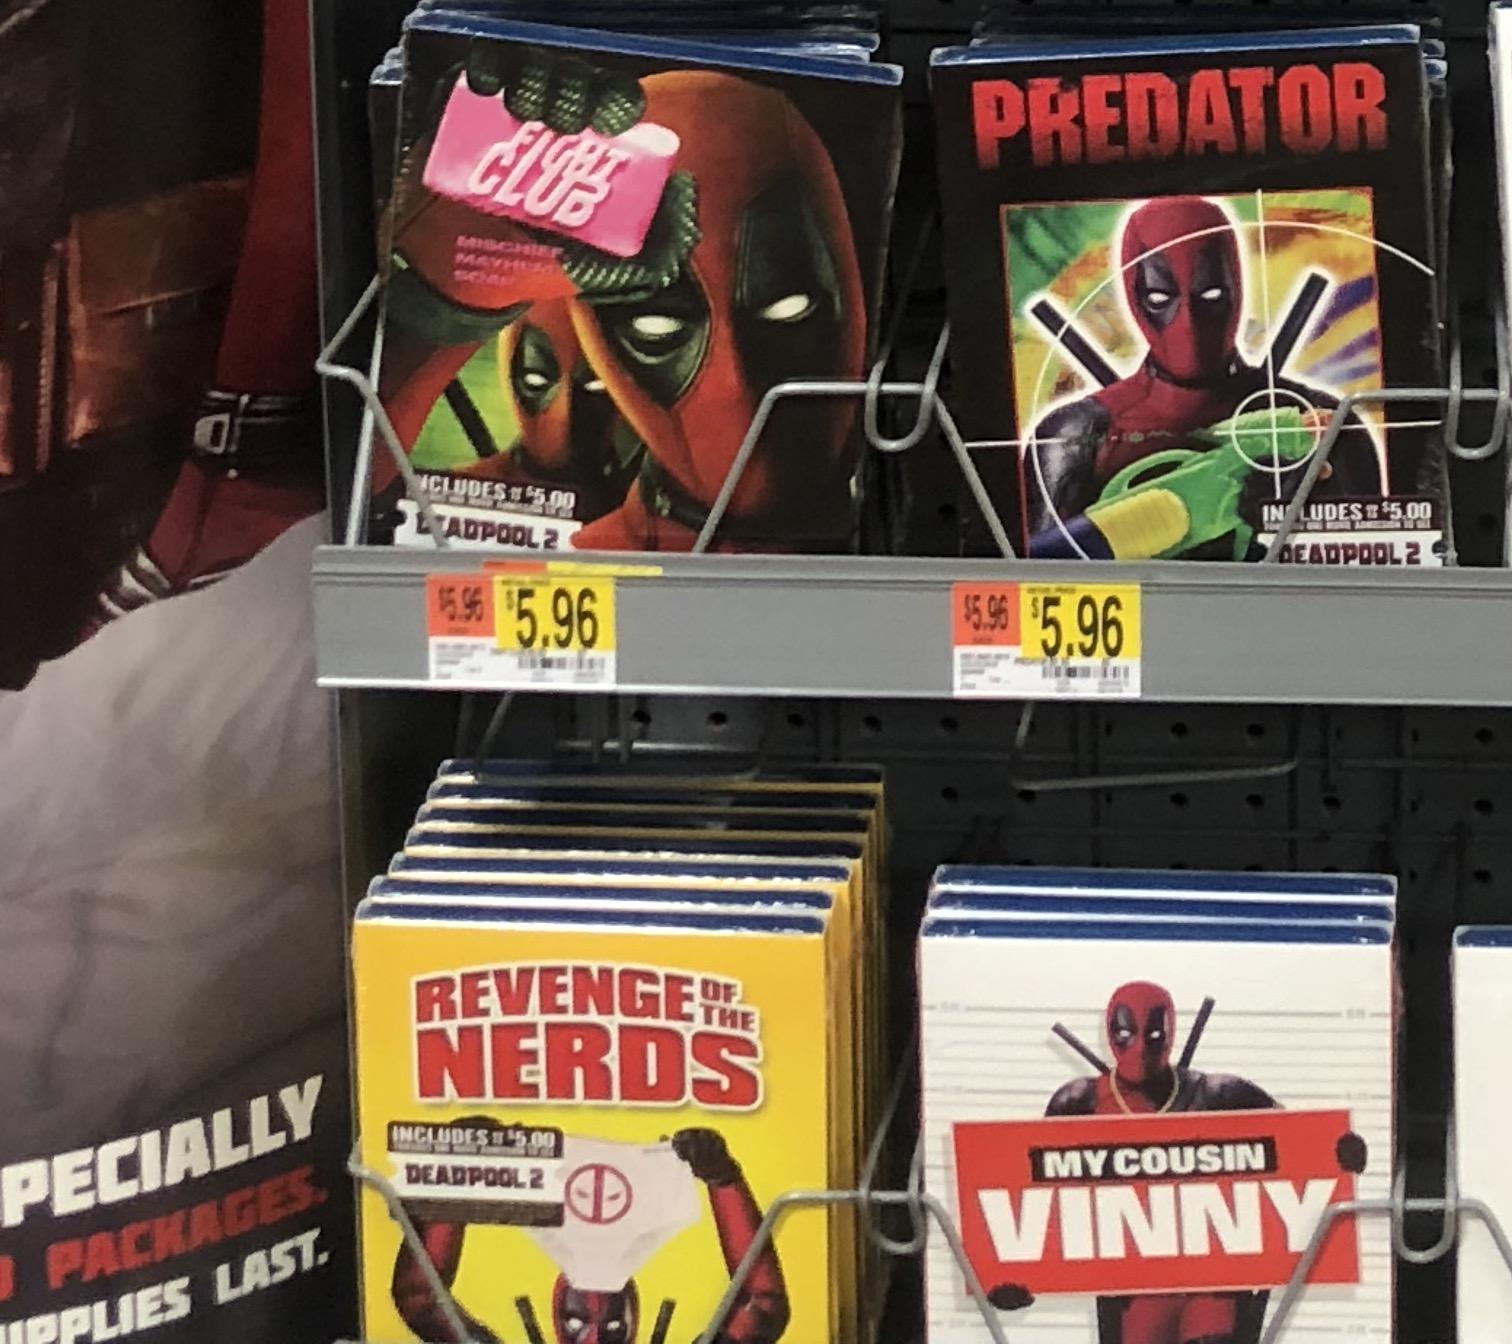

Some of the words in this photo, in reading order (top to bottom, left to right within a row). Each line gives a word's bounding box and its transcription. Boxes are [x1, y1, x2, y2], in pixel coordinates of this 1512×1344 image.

[970, 62, 1388, 173] PREDATOR
[510, 120, 632, 182] FIGHT
[467, 141, 612, 227] CLUB
[414, 474, 506, 501] NCLUDES
[526, 485, 576, 510] $5.00
[1381, 501, 1432, 520] $5.00
[543, 527, 560, 550] 2
[1278, 542, 1400, 565] DEADPOOL
[1405, 542, 1421, 565] 2
[438, 586, 485, 622] $5.96
[505, 586, 599, 649] $5.96
[964, 594, 1009, 630] $5.96
[1031, 595, 1124, 657] $5.96
[414, 963, 696, 1026] REVENGE
[700, 978, 739, 1005] OF
[700, 1002, 757, 1033] THE
[415, 1020, 763, 1108] NERDS
[1, 1074, 324, 1228] PECIALLY
[392, 1125, 489, 1146] INCLUDES
[508, 1129, 555, 1148] $5.00
[1042, 1149, 1107, 1180] MY
[1119, 1142, 1266, 1177] COUSIN
[405, 1163, 527, 1189] DEADPOOL
[529, 1168, 544, 1189] 2
[46, 1165, 328, 1290] PACKAGES.
[977, 1177, 1338, 1264] VINNY
[215, 1228, 331, 1305] LAST.
